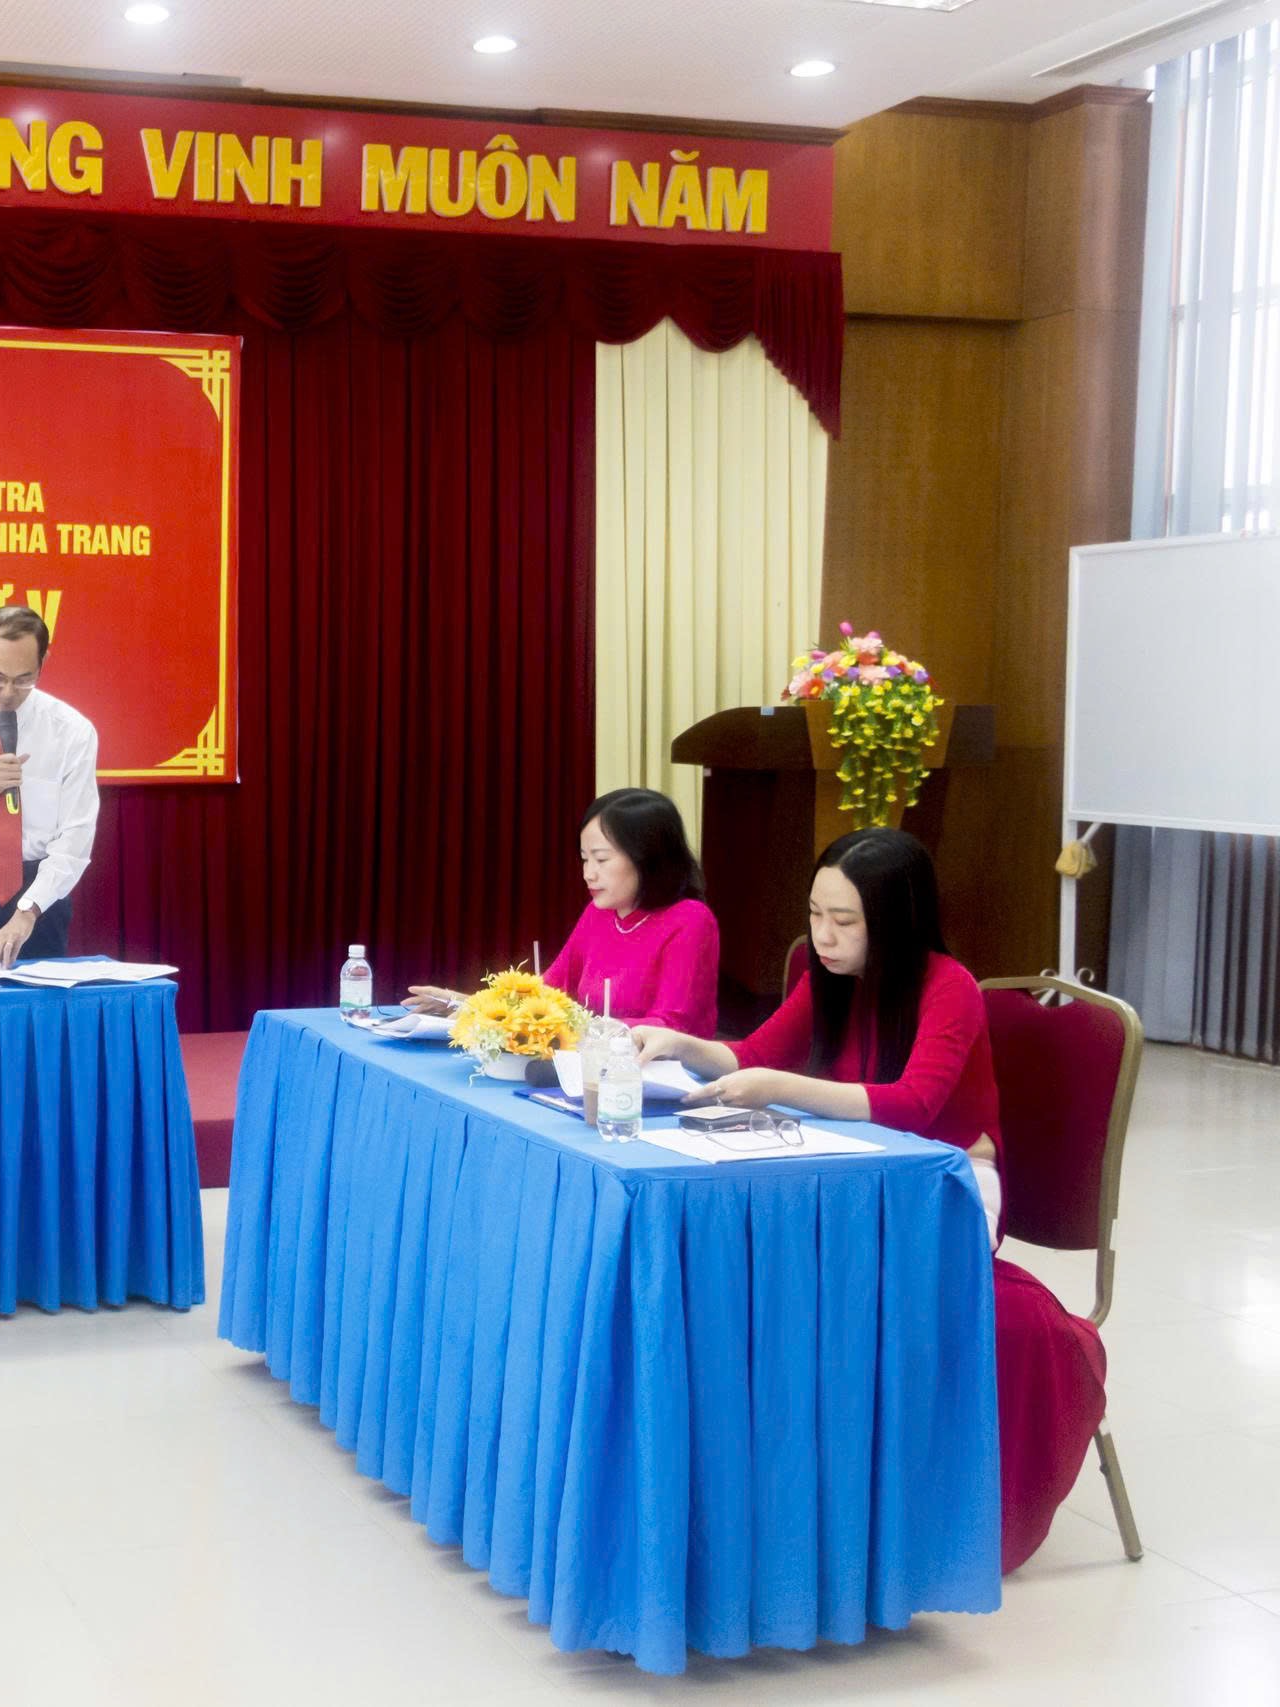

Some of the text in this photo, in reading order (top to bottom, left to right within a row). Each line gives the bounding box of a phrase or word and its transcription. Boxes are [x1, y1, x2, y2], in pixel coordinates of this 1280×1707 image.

[140, 128, 323, 208] VINH
[360, 134, 577, 222] MUÔN
[609, 150, 769, 234] NĂM
[56, 524, 151, 556] TRANG
[26, 590, 62, 644] V
